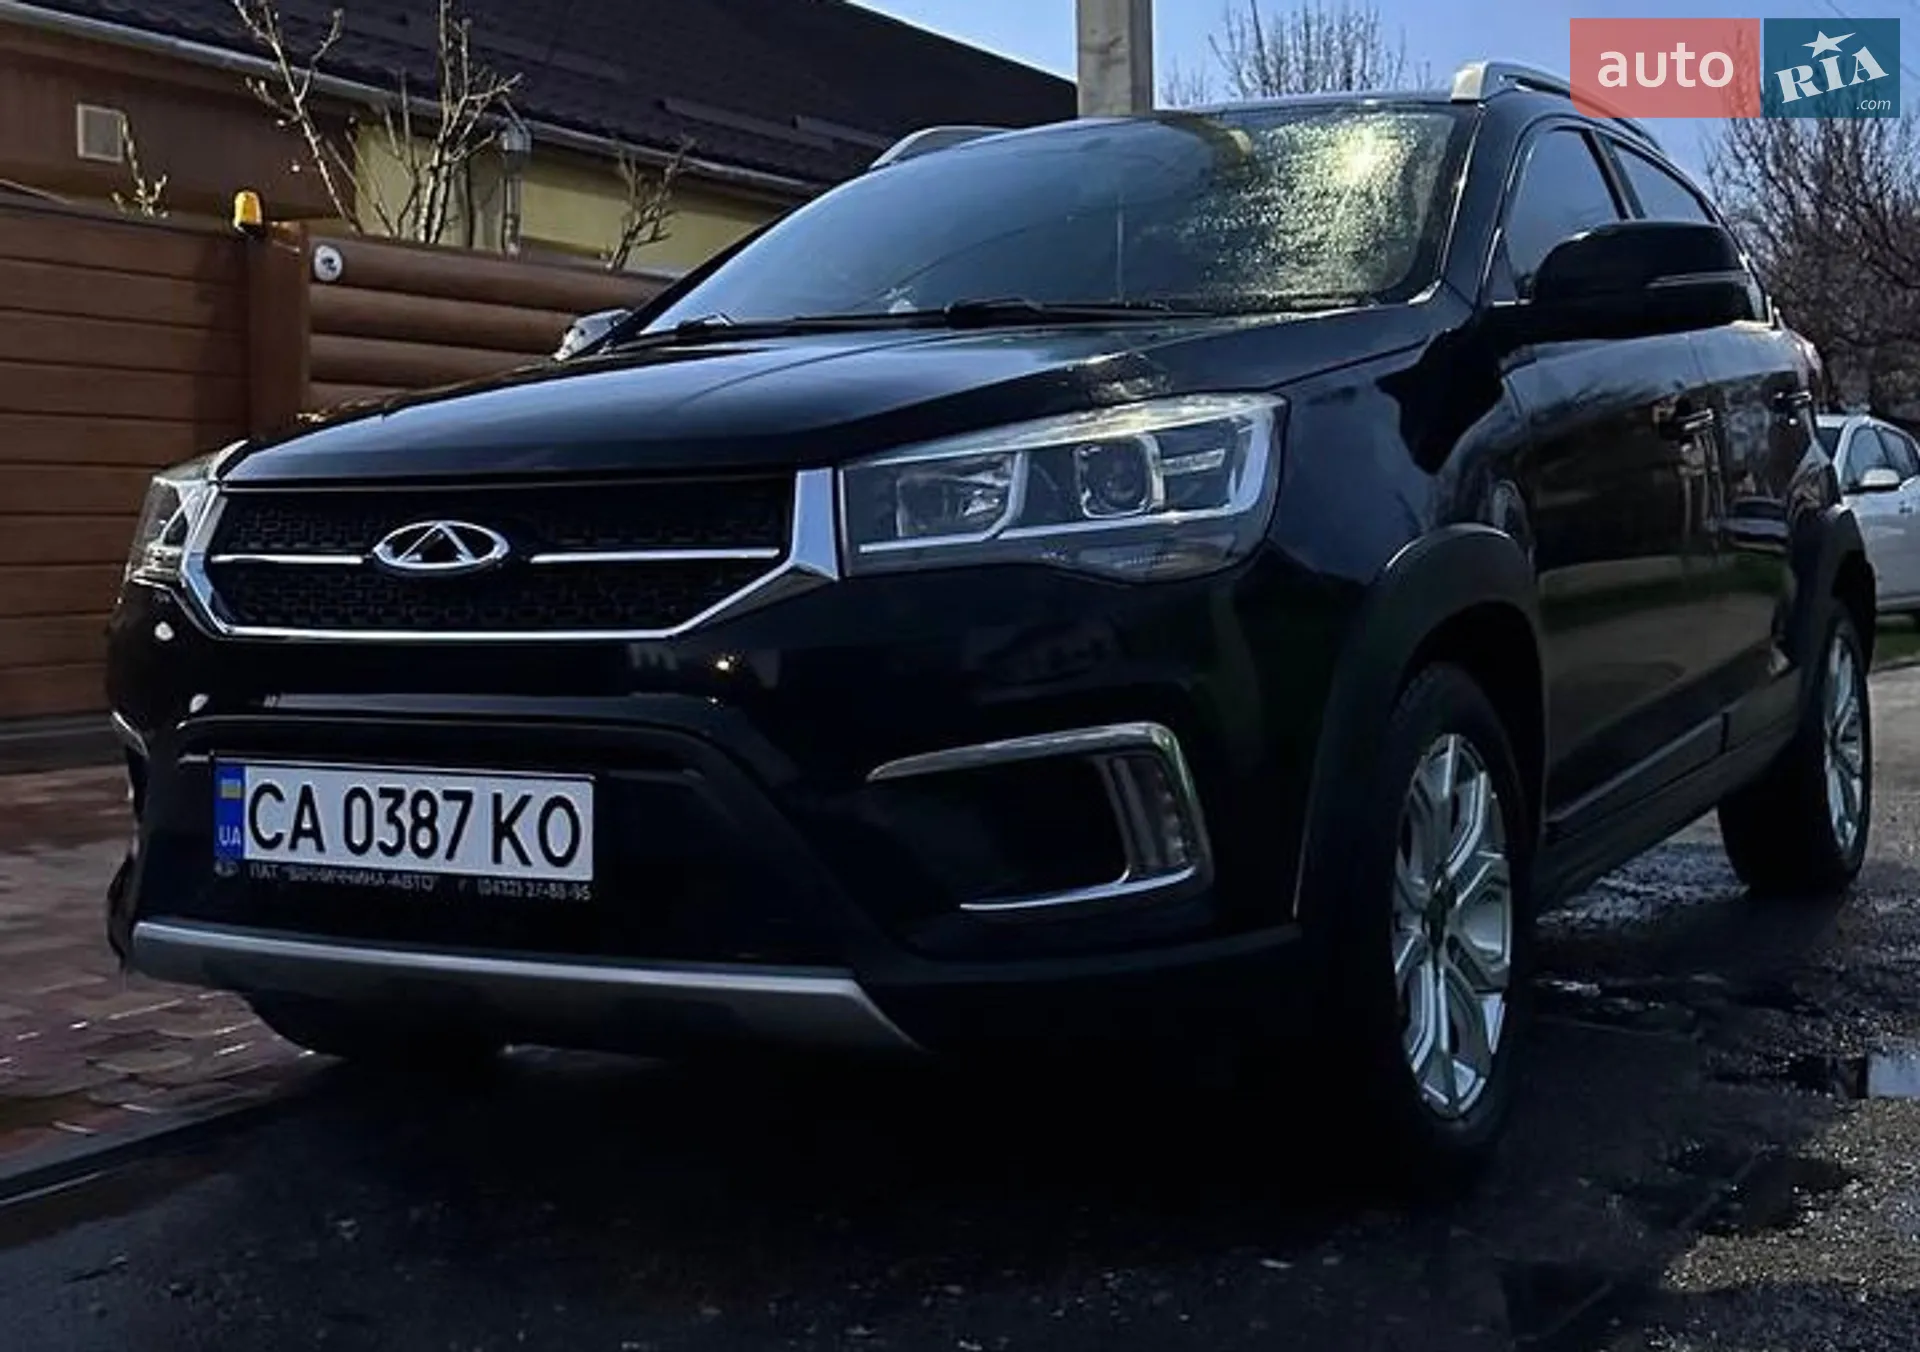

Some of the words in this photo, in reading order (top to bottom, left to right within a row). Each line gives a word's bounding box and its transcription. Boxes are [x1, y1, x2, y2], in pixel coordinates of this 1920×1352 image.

[219, 825, 241, 847] UA
[248, 783, 326, 853] CA
[343, 787, 475, 861] 0387
[491, 792, 581, 868] KO
